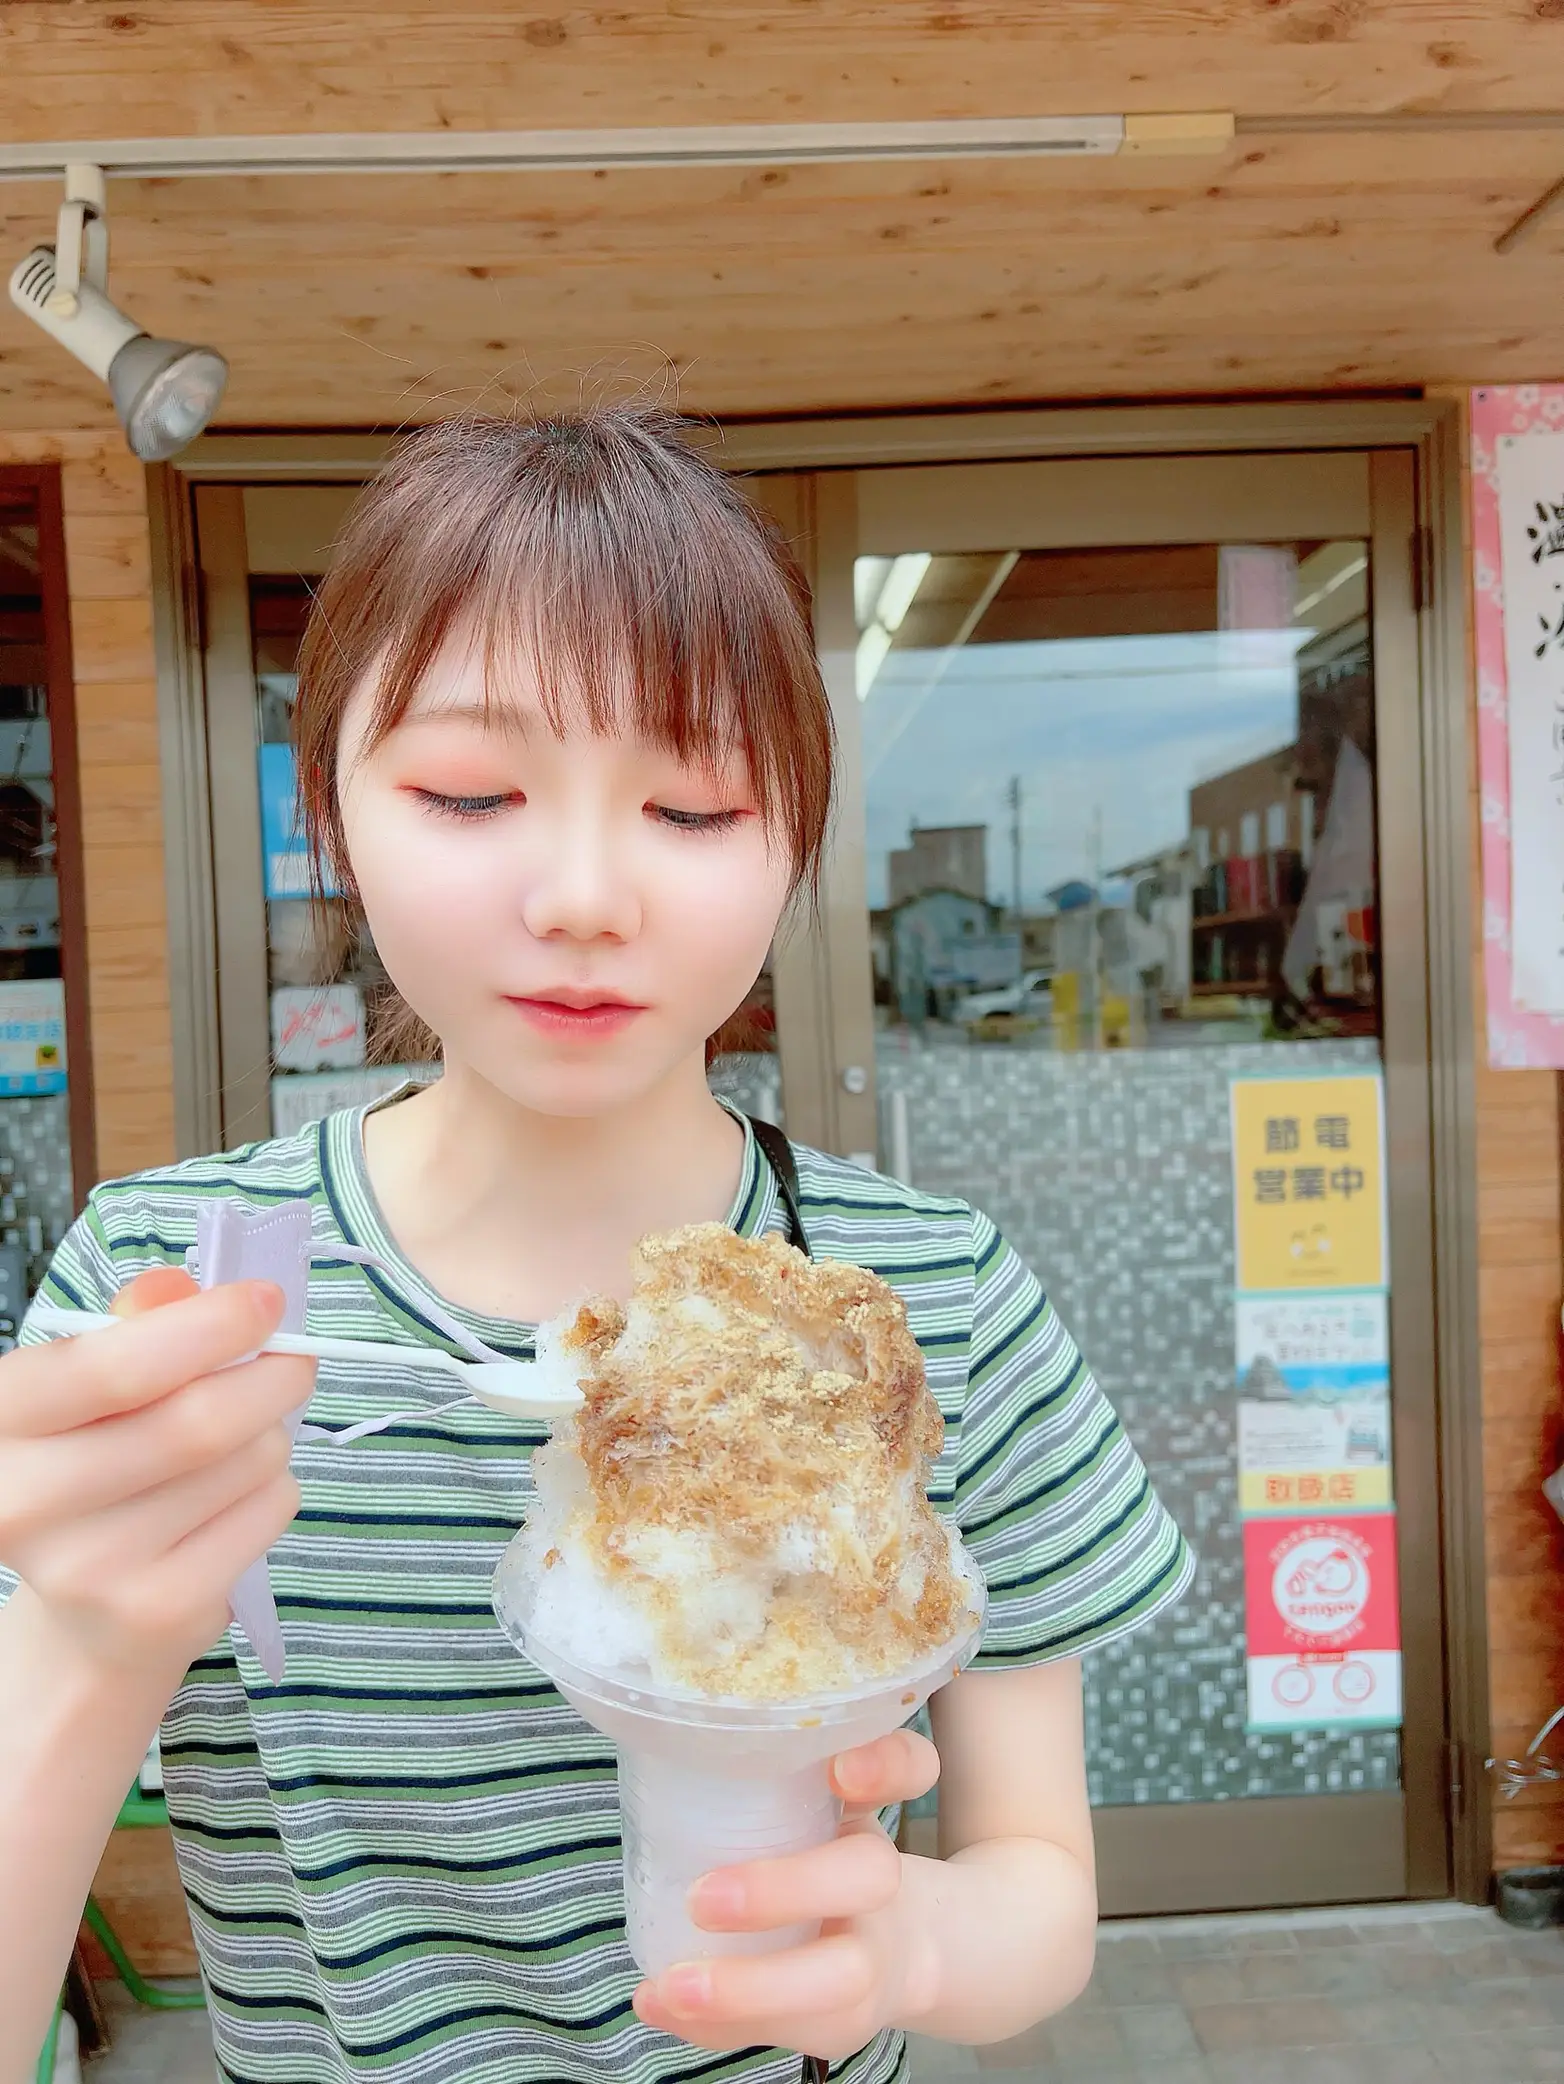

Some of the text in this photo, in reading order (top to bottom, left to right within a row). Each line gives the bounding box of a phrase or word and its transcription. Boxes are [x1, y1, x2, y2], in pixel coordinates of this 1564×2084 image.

[1266, 1115, 1349, 1153] 節電
[1254, 1165, 1363, 1202] 営業中
